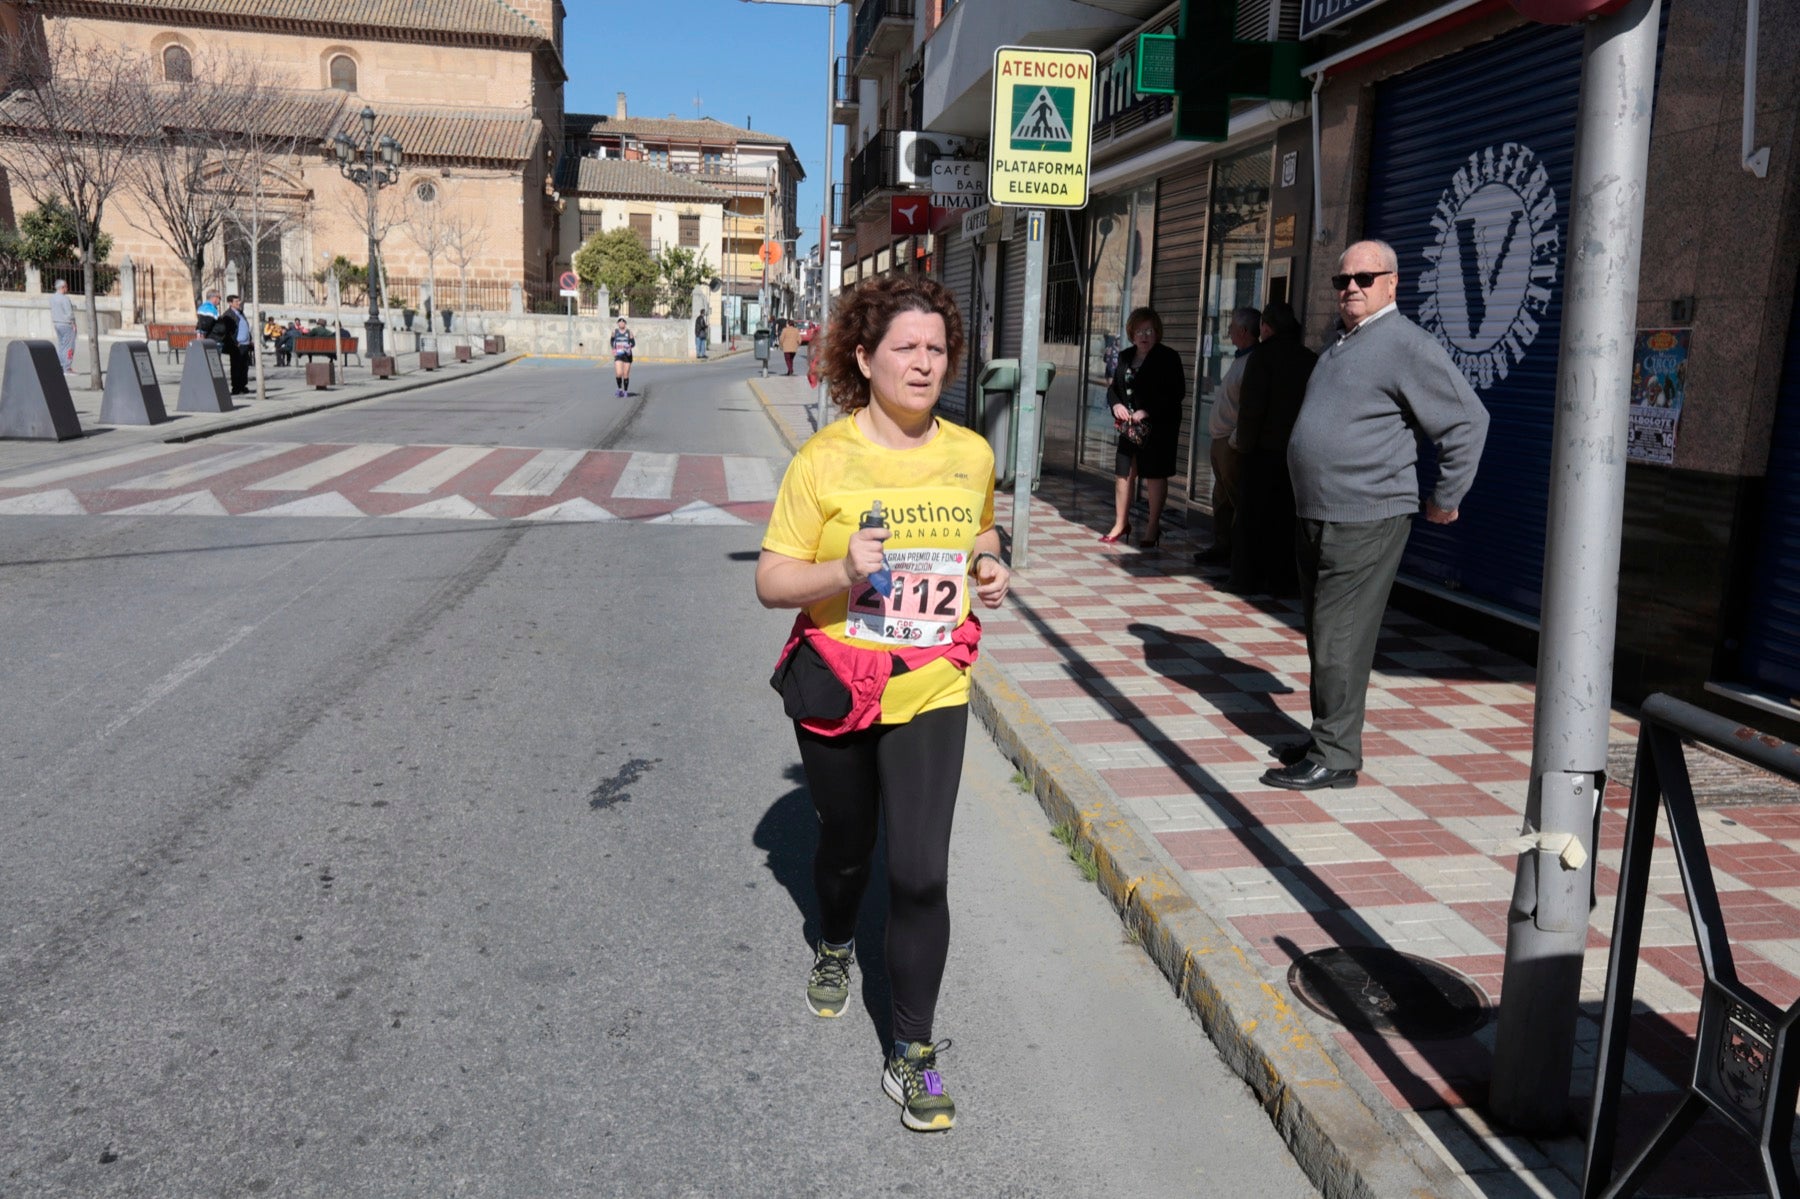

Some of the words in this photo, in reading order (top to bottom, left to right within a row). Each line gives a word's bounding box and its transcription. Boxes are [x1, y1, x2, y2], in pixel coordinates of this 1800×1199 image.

[1002, 60, 1089, 80] ATENCION
[933, 163, 971, 176] CAFÉ
[996, 159, 1084, 176] PLATAFORMA
[957, 180, 984, 191] BAR
[1009, 180, 1069, 196] ELEVADA
[1454, 210, 1524, 339] V
[894, 528, 961, 540] RANADA
[931, 552, 941, 561] DE
[941, 553, 959, 562] FOND
